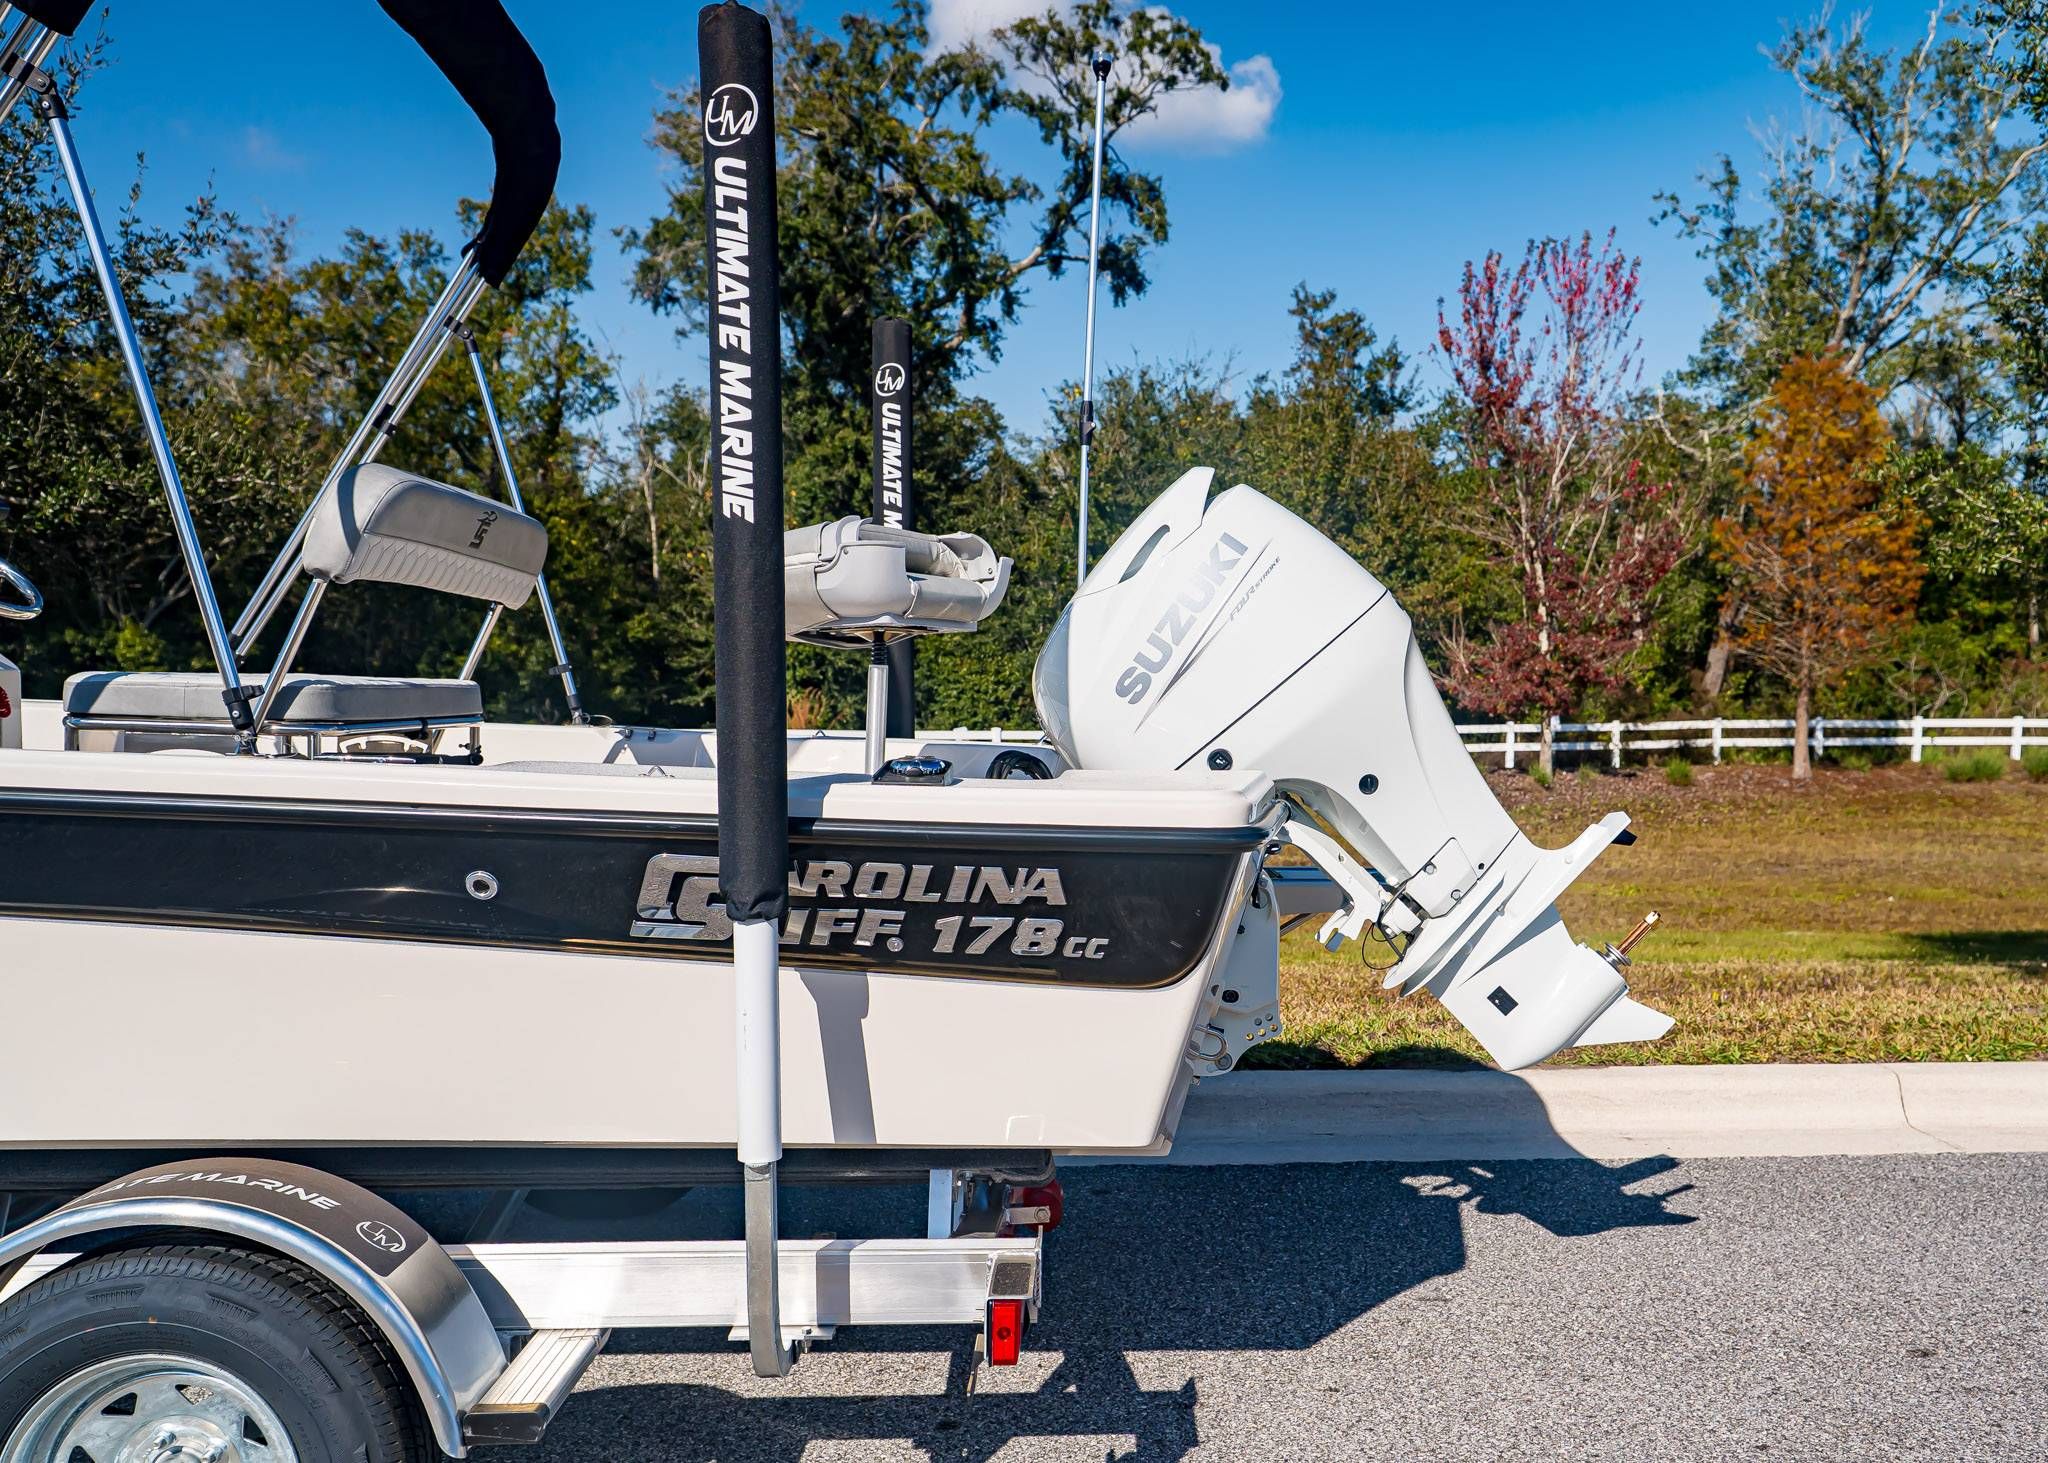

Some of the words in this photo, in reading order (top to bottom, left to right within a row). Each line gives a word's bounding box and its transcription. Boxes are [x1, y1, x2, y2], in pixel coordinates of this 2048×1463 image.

[714, 157, 751, 354] ULTIMATE
[719, 360, 754, 523] MARINE
[882, 402, 903, 508] ULTIMATE
[1115, 532, 1249, 705] SUZUKI
[178, 1172, 342, 1210] MARINE
